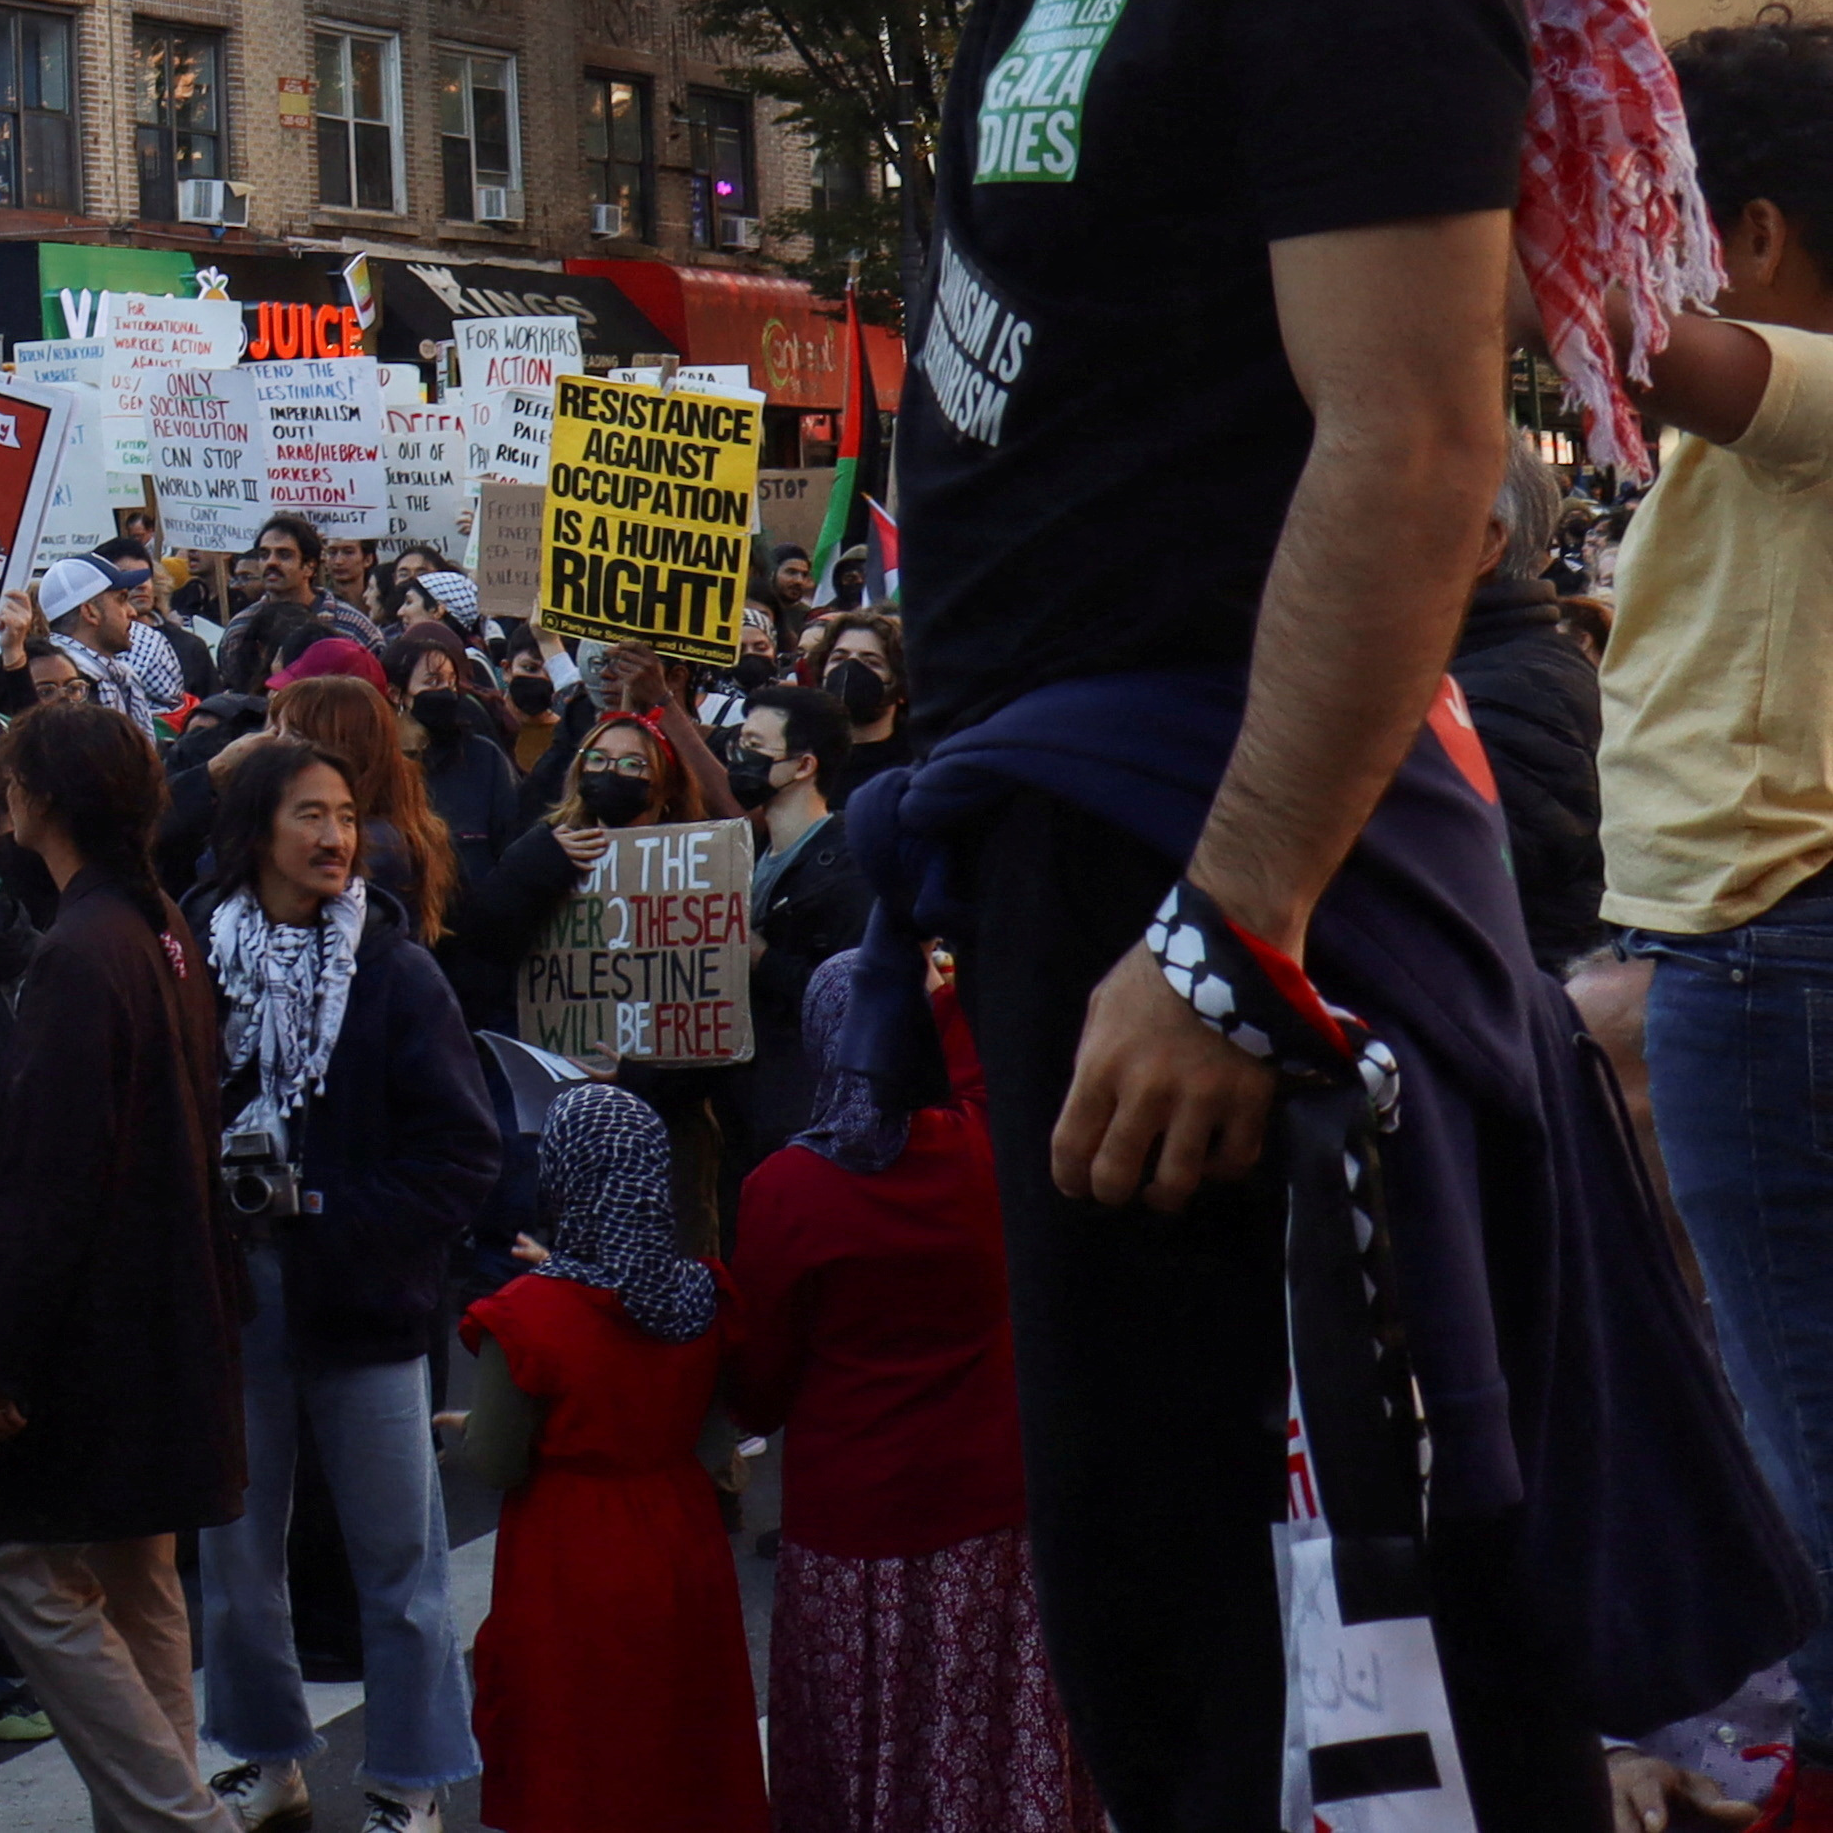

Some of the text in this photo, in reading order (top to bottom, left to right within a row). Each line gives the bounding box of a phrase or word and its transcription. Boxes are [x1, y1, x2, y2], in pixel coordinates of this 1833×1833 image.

[986, 48, 1093, 111] GAZA
[976, 110, 1076, 175] DIES
[407, 264, 598, 325] KINGS
[127, 300, 146, 316] FOR
[113, 316, 203, 335] INTERNATIONAL
[249, 301, 365, 359] JUICE
[113, 336, 213, 355] WORKERS ACTION
[465, 324, 579, 356] FOR WORKERS
[987, 312, 1032, 384] IS
[304, 362, 335, 379] THE
[486, 356, 553, 387] ACTION
[167, 372, 213, 397] ONLY
[149, 394, 231, 421] SOCIALIST
[270, 405, 362, 422] IMPERIALISM
[471, 402, 491, 426] TO
[559, 381, 754, 446] RESISTANCE
[153, 418, 248, 444] REVOLUTION
[272, 425, 315, 440] OUT!
[162, 446, 243, 469] CAN STOP
[276, 442, 378, 463] ARAB/HEBREW
[399, 441, 445, 460] OUT OF
[495, 444, 541, 470] RIGHT
[582, 428, 721, 483] AGAINST
[155, 474, 203, 499] WORLD
[207, 478, 239, 499] WAR
[384, 466, 454, 486] JERUSALEM
[551, 463, 749, 528] OCCUPATION
[759, 478, 809, 501] STOP
[190, 506, 219, 522] CUNY
[405, 495, 431, 512] THE
[553, 508, 584, 546] IS
[588, 513, 611, 550] A
[616, 522, 741, 575] HUMAN
[550, 547, 737, 642] RIGHT!
[560, 619, 735, 662] Party for and Liberation
[635, 831, 716, 893] THE
[607, 896, 633, 951] 2
[629, 895, 683, 948] THE
[681, 891, 748, 946] SEA
[528, 947, 721, 1004] PALESTINE
[537, 1000, 735, 1058] WILL BE FREE
